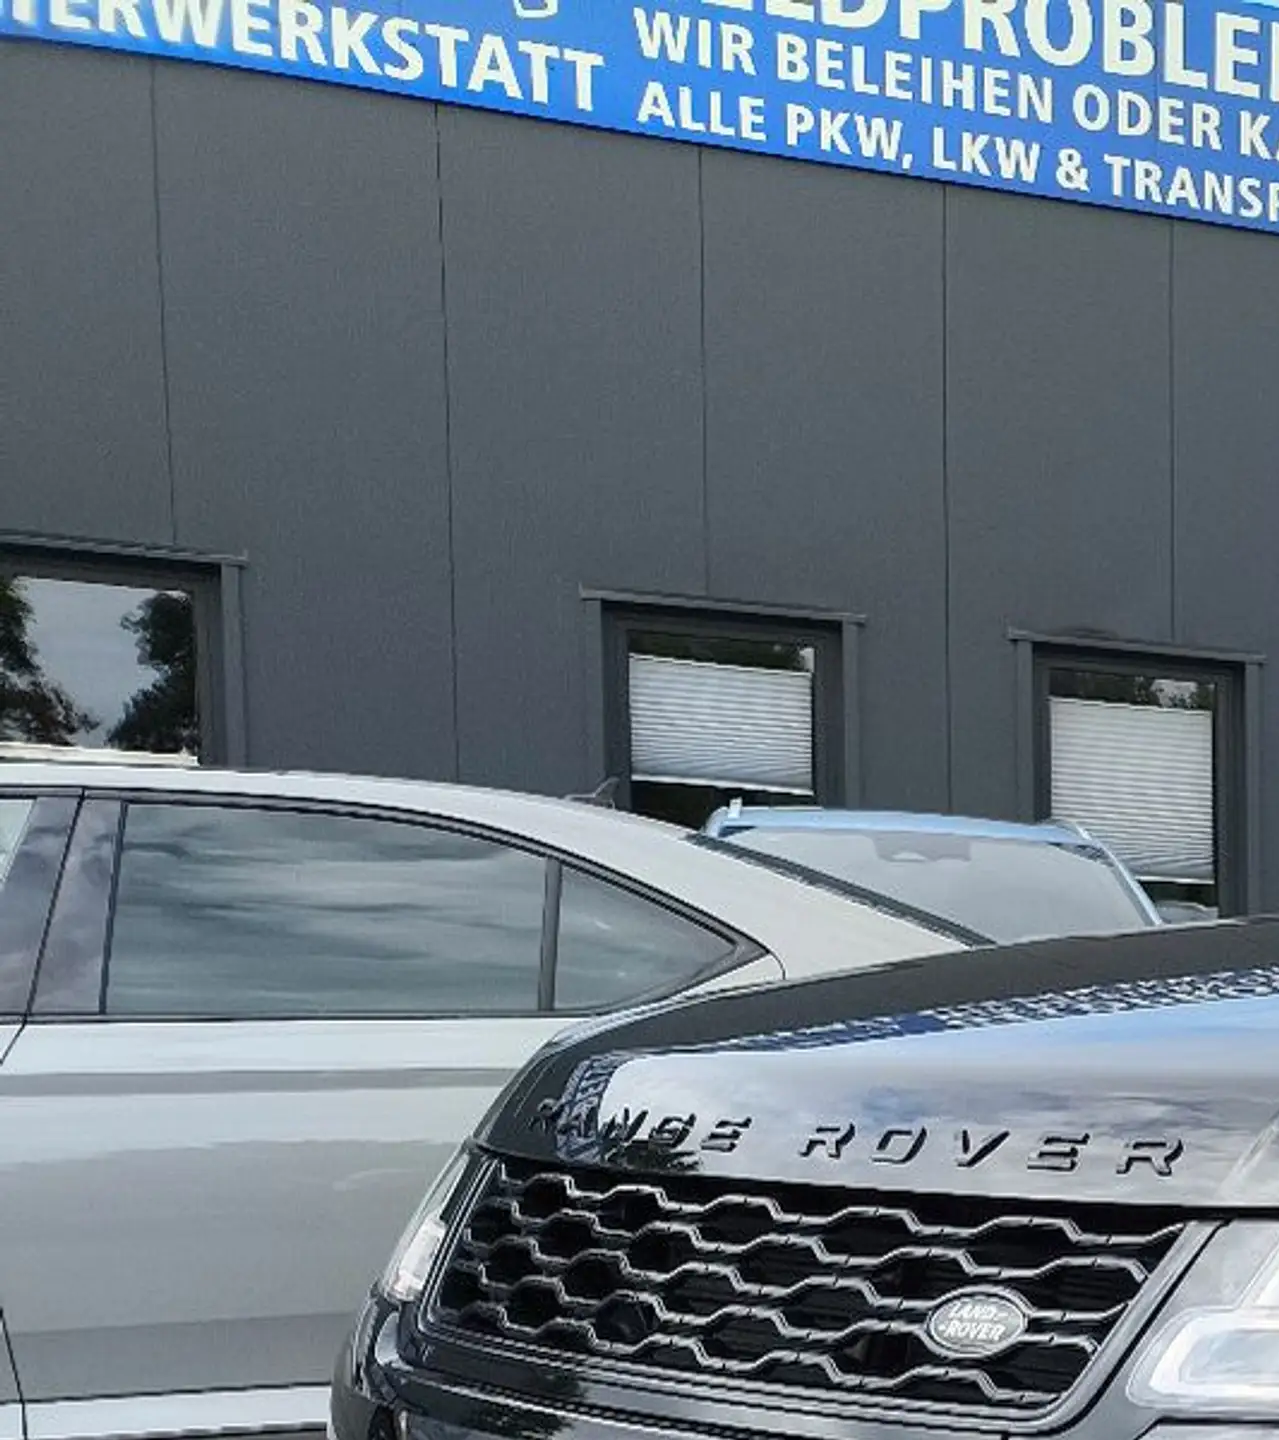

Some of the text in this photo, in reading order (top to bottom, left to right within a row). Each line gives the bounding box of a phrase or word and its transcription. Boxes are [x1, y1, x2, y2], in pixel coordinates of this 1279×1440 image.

[633, 6, 757, 76] WIR
[776, 31, 1053, 124] BELEIHEN
[1073, 83, 1223, 151] ODER
[636, 80, 768, 143] ALLE
[786, 102, 914, 170] PKW,
[933, 126, 1041, 184] LKW
[1055, 147, 1091, 193] &
[799, 1122, 1185, 1177] ROVER
